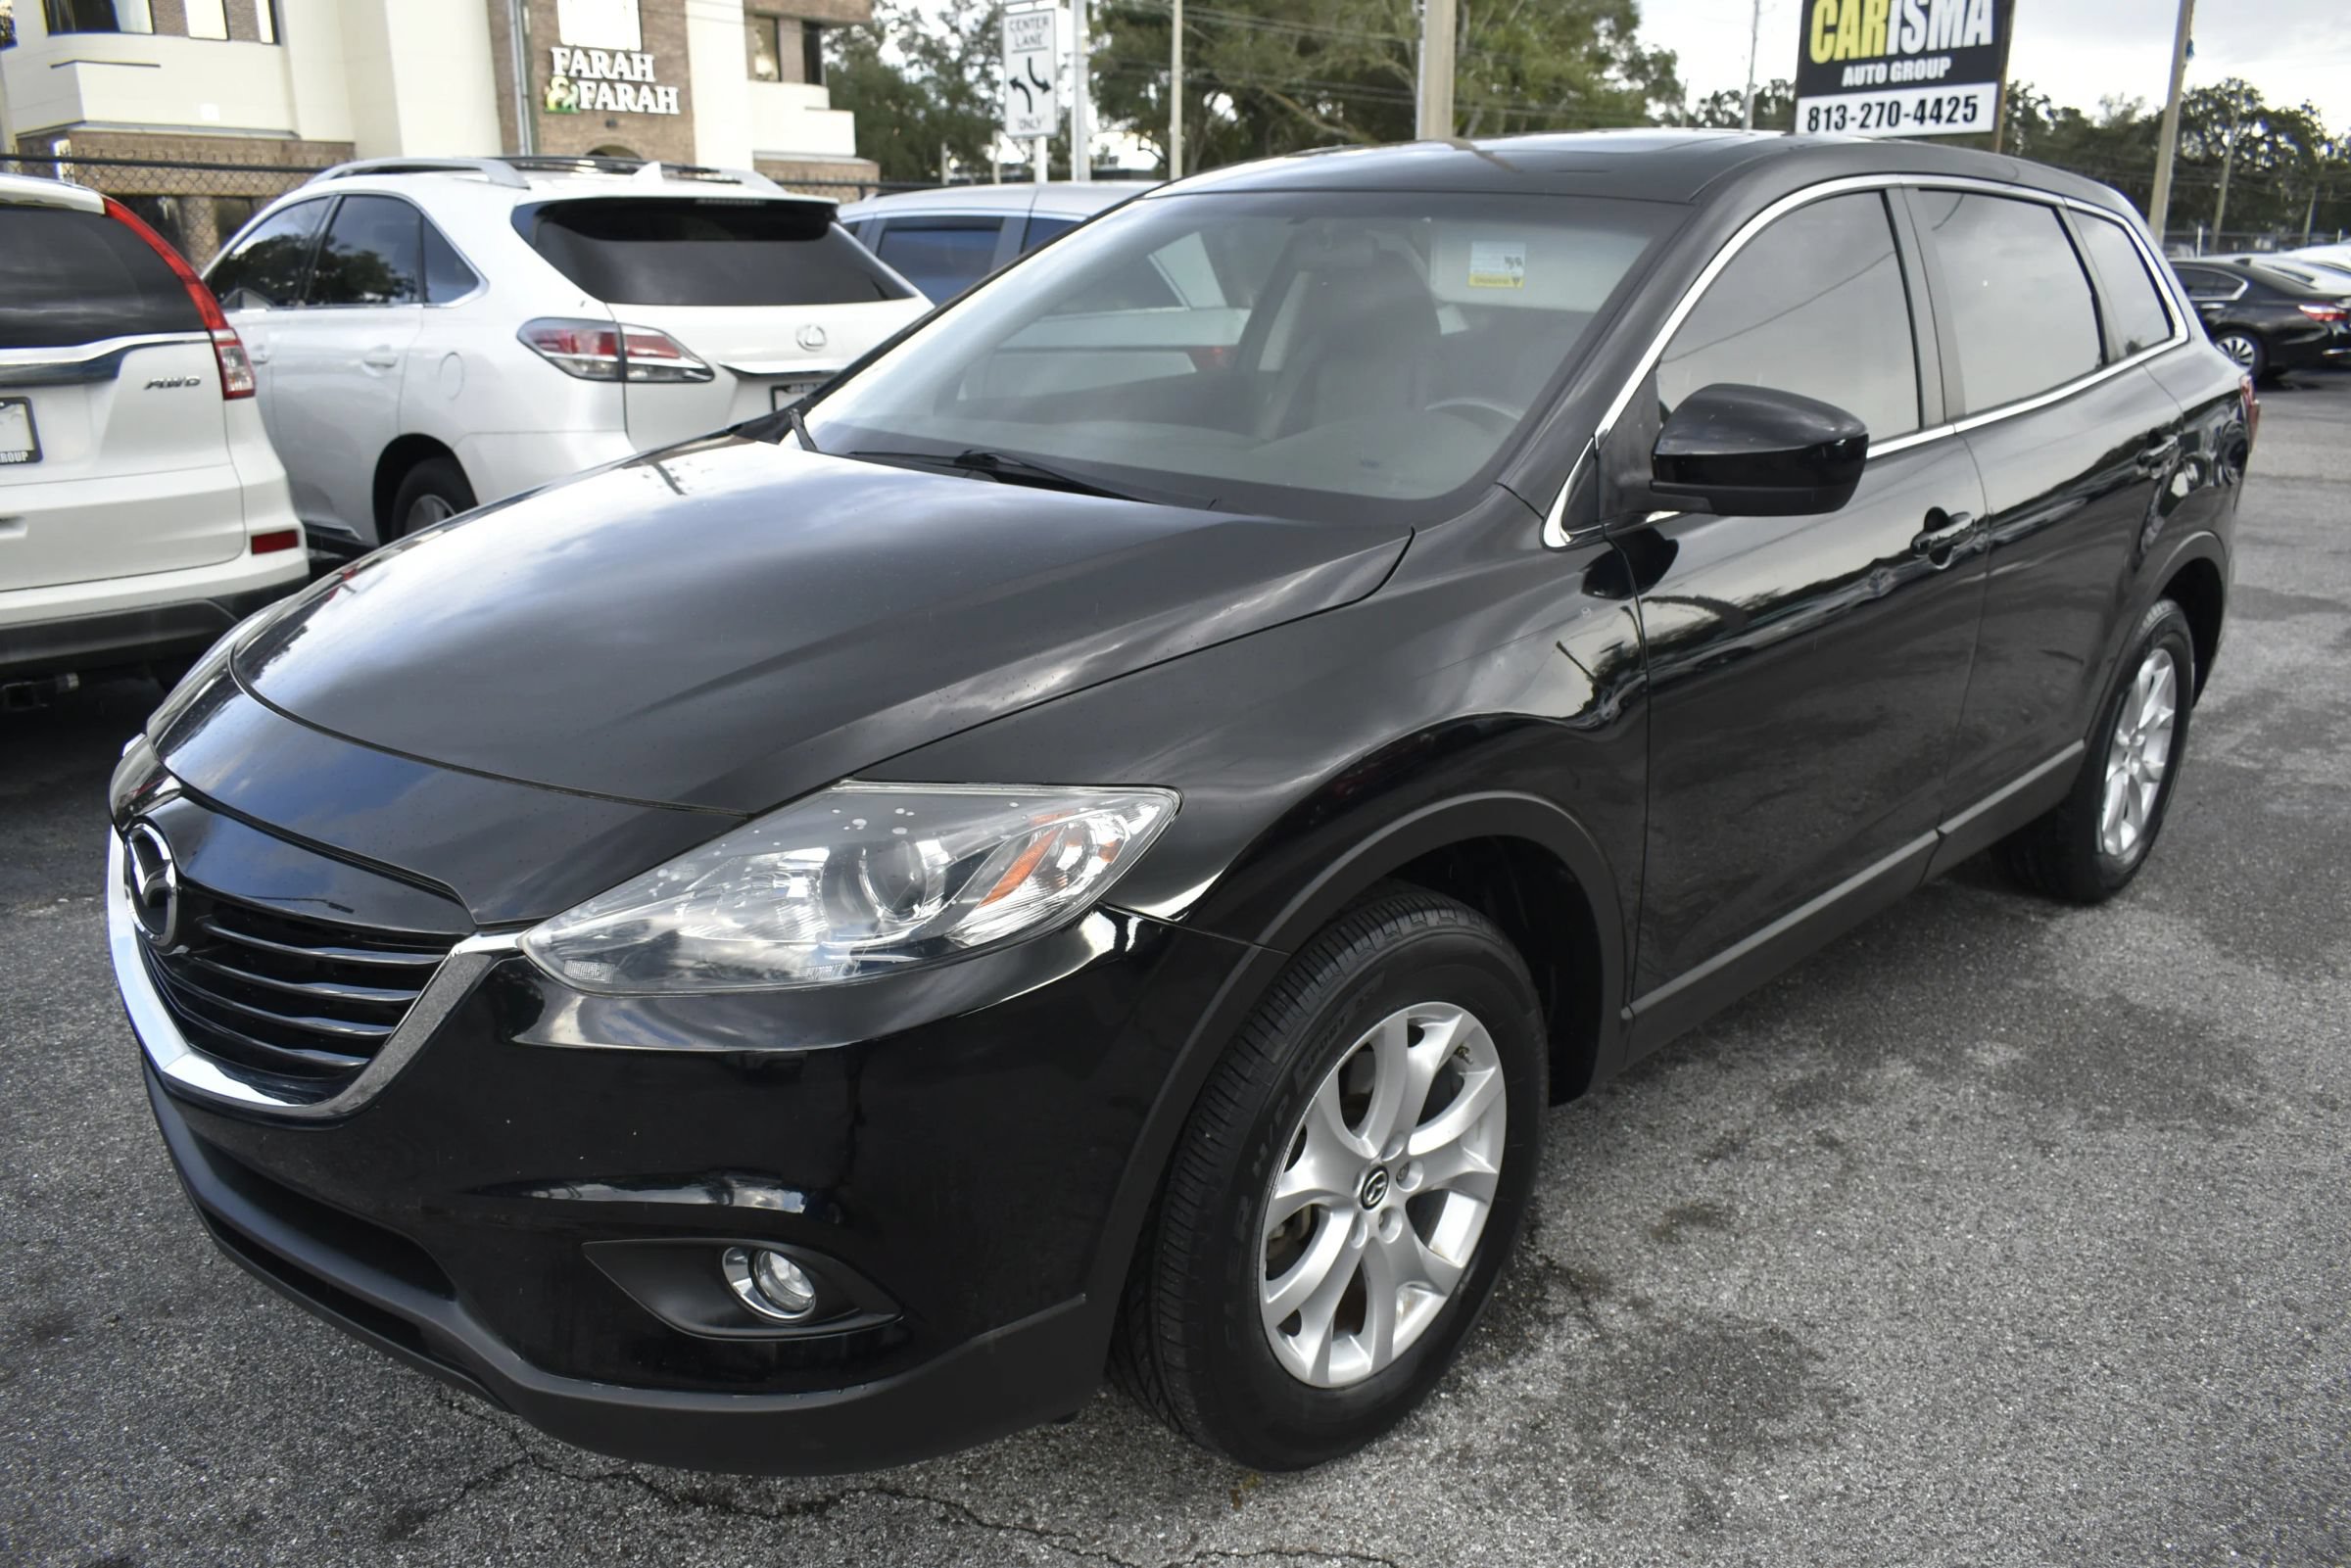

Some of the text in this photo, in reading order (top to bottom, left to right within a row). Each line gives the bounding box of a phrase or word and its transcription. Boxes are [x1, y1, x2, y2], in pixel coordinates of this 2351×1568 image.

[1009, 17, 1048, 32] CENTER
[1810, 0, 1992, 64] CARISMA
[1015, 34, 1042, 47] LANE
[551, 47, 655, 82] FARAH
[1842, 57, 1951, 87] AUTO GROUP
[577, 79, 680, 115] FARAH
[1019, 117, 1042, 129] ONLY
[1807, 95, 1978, 132] 813-270-4425
[144, 376, 201, 391] AWD
